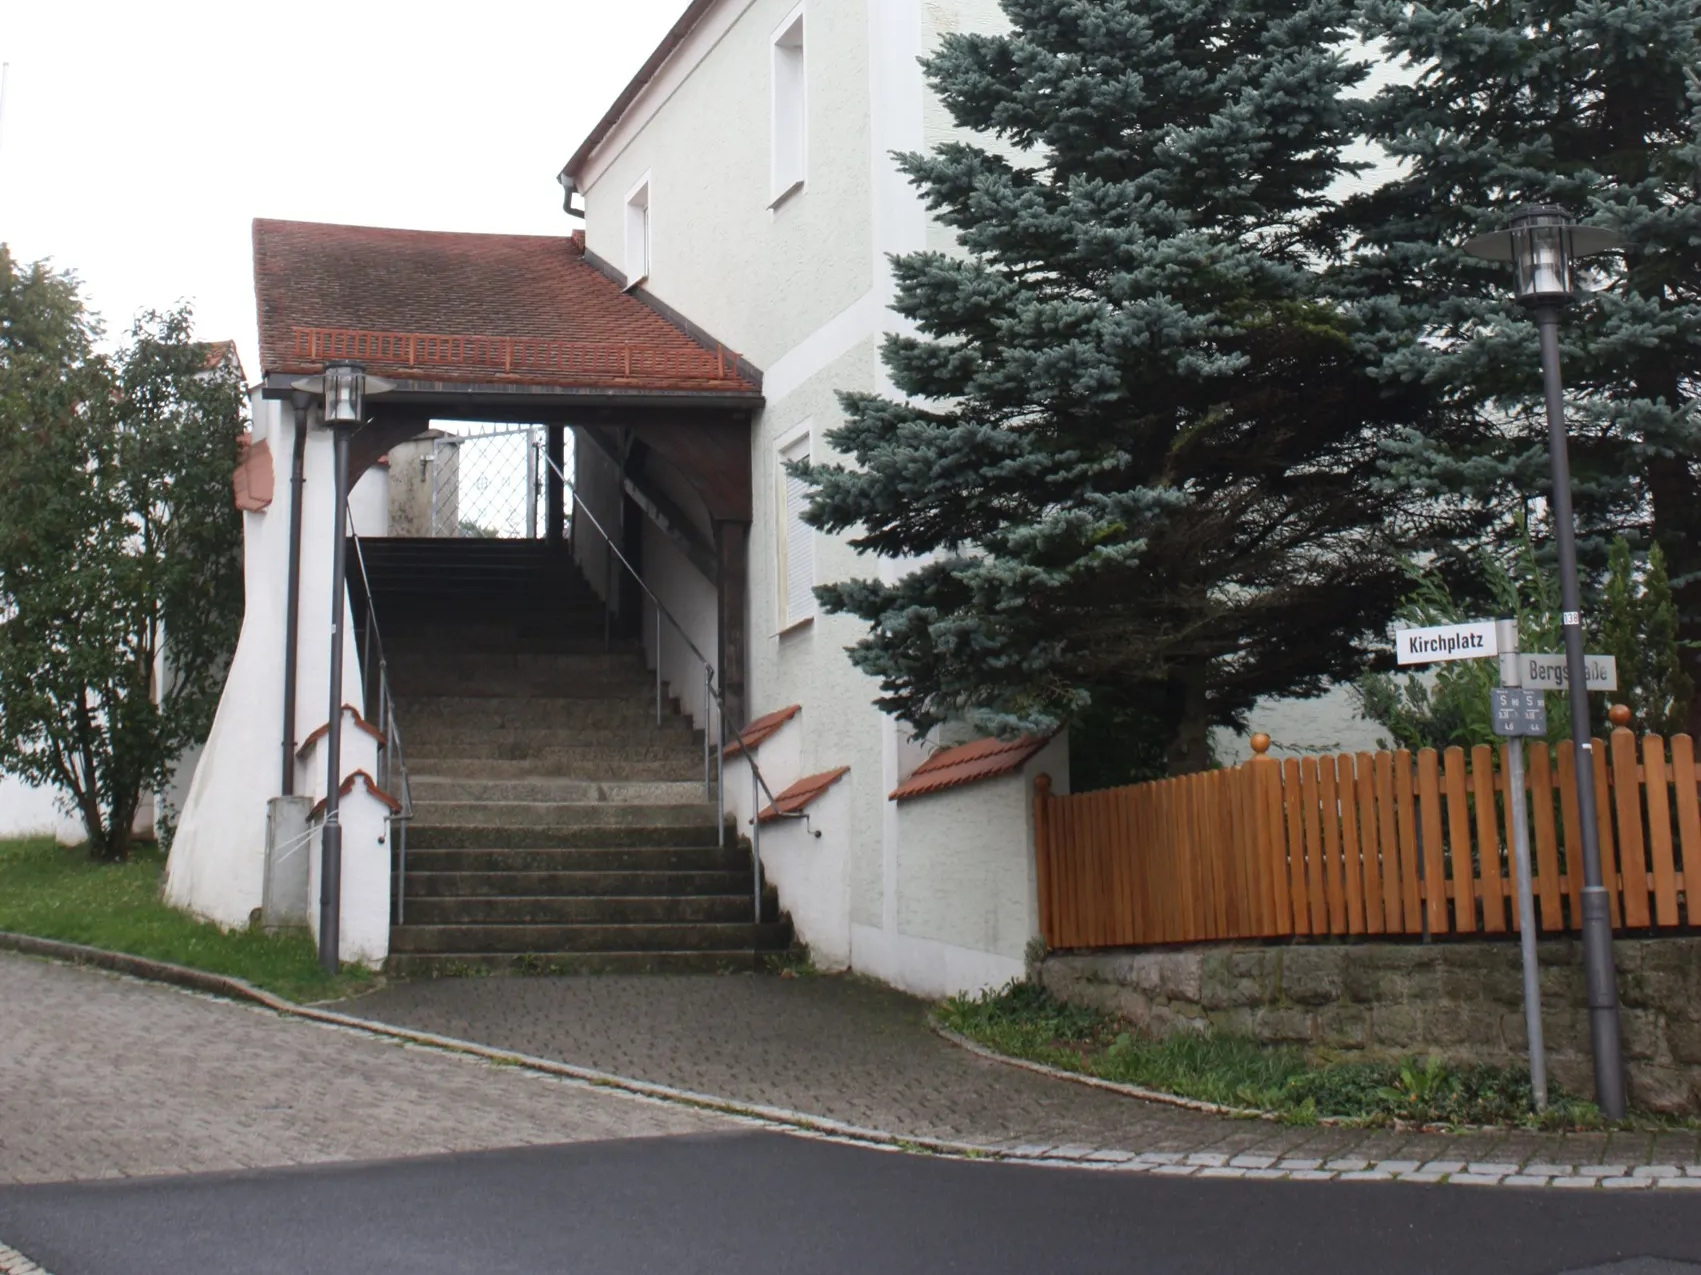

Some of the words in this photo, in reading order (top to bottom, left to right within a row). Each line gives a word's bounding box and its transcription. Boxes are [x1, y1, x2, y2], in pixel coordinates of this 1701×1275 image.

[1564, 613, 1578, 623] 138
[1410, 632, 1484, 654] Kirchplatz
[1530, 660, 1607, 686] Bergsaße
[1500, 694, 1507, 705] S
[1526, 695, 1533, 706] S
